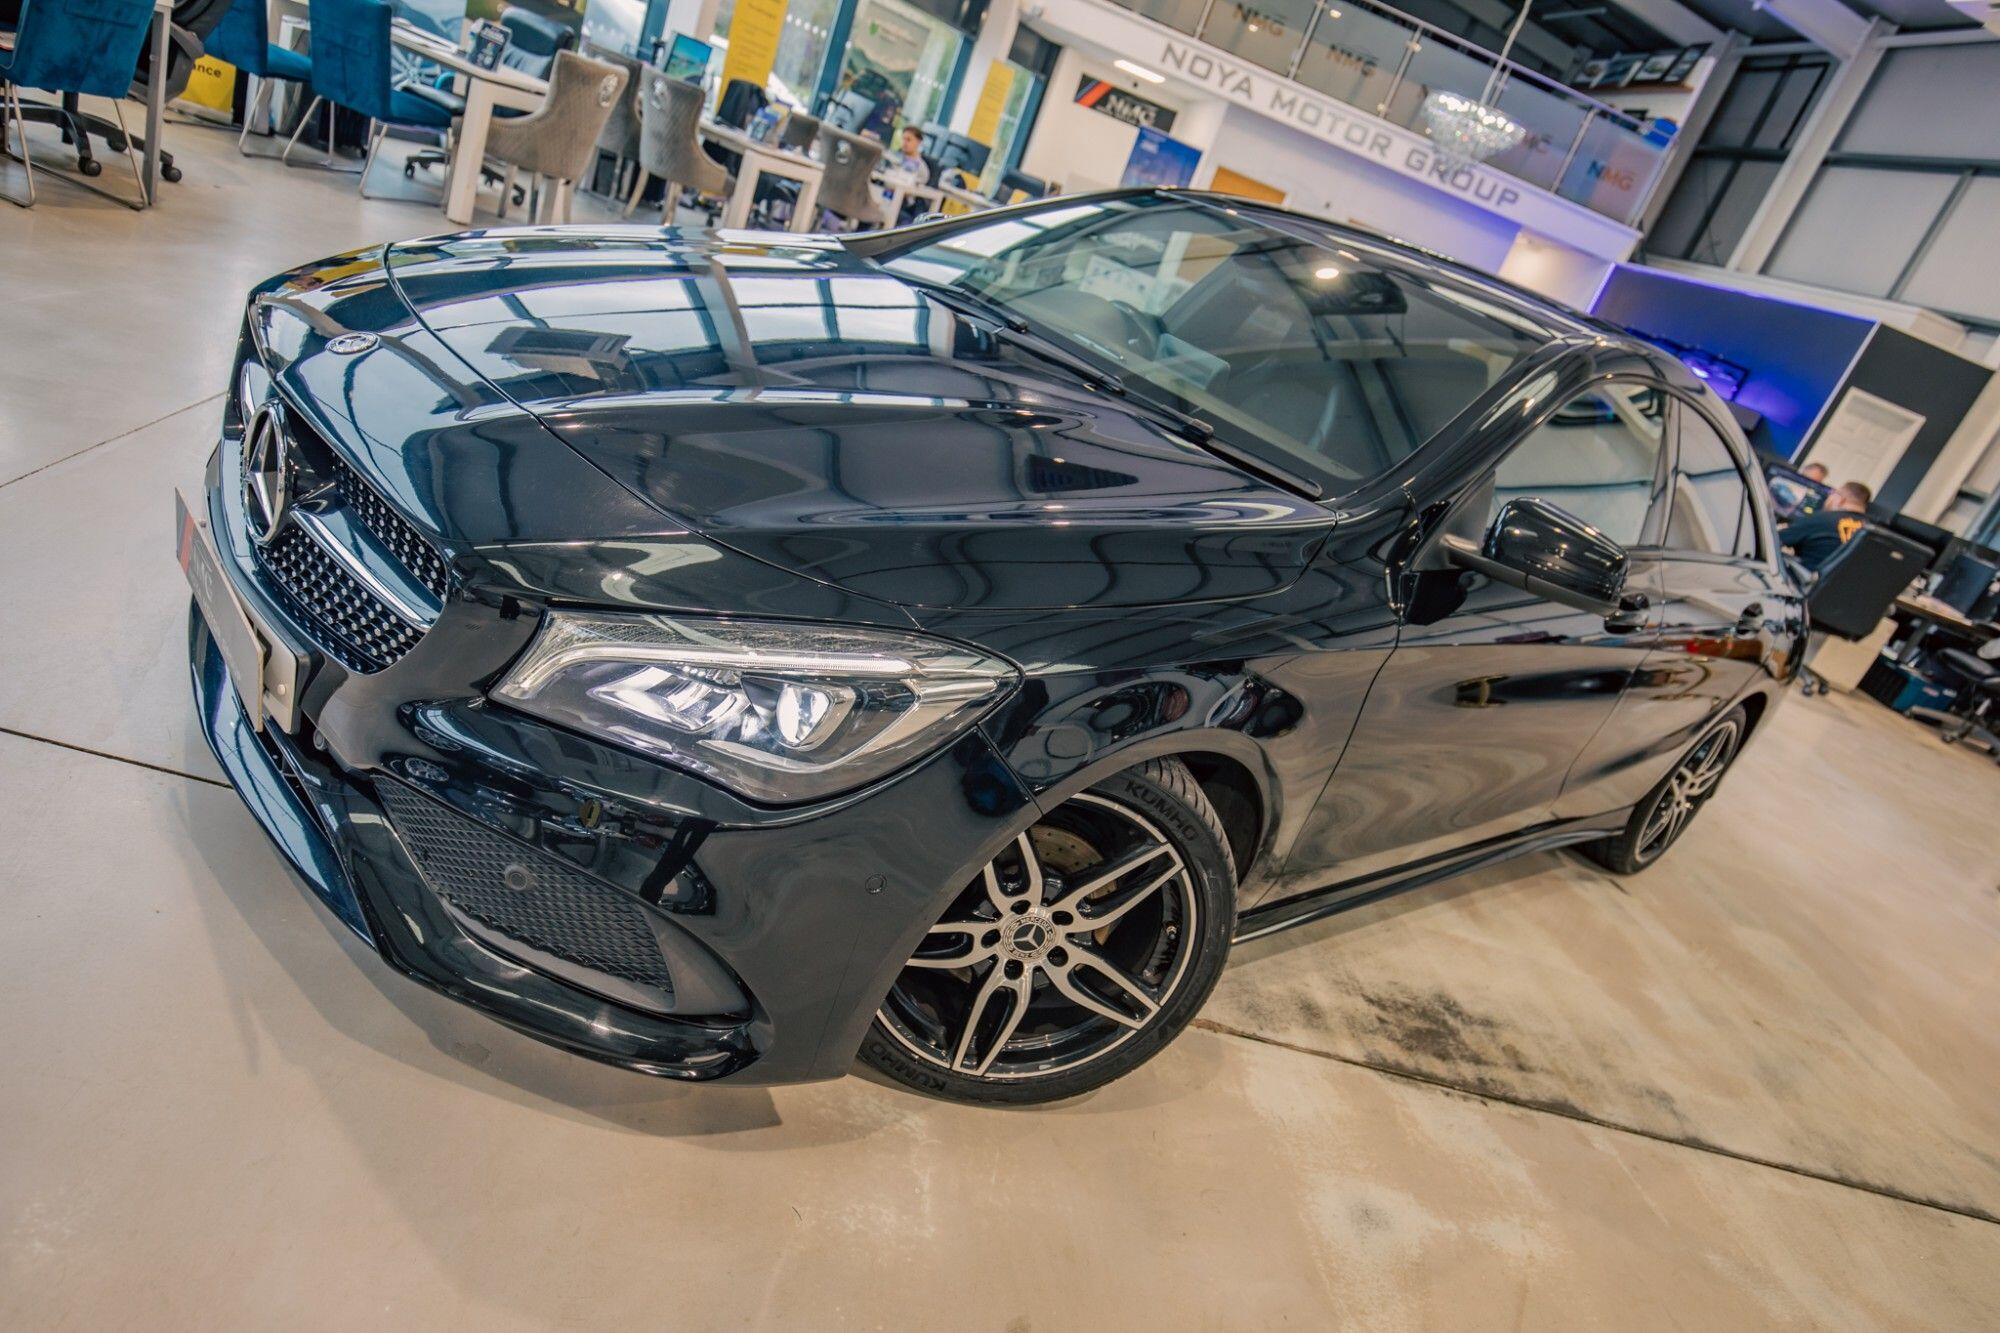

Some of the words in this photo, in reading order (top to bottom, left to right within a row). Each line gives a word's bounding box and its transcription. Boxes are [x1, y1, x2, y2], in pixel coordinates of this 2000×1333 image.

[1106, 93, 1158, 127] NMG
[1160, 42, 1253, 99] NOYA
[1269, 88, 1394, 159] MOTOR
[1406, 148, 1520, 207] GROUP
[1125, 779, 1199, 841] KUMHO
[871, 1042, 947, 1092] KUMHO
